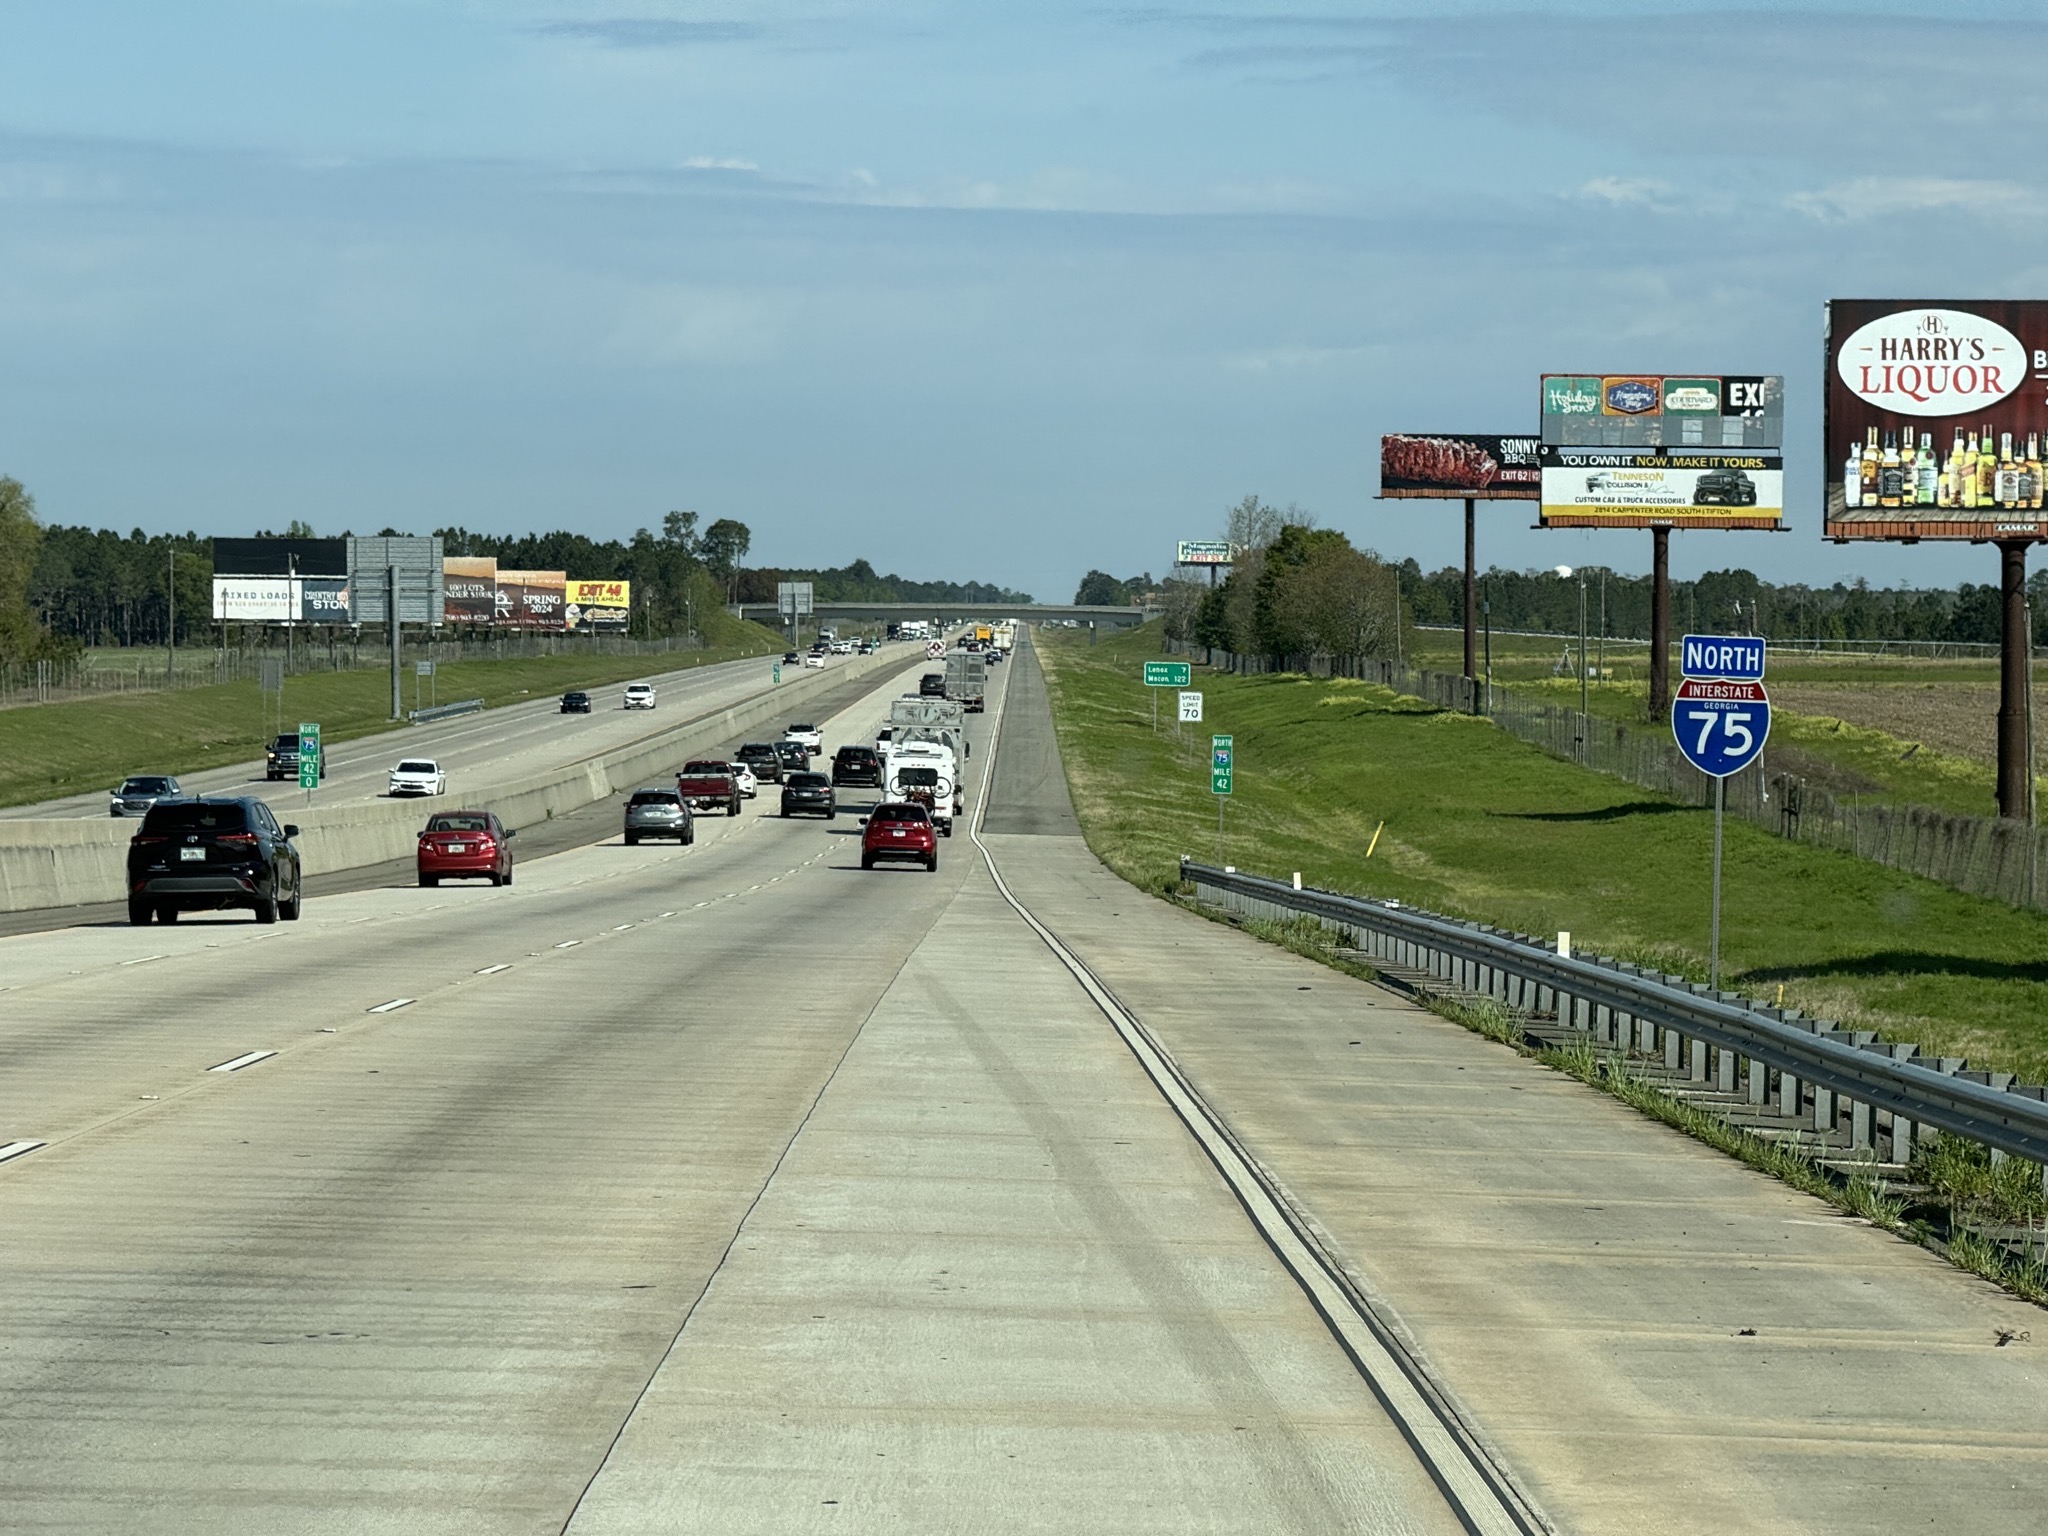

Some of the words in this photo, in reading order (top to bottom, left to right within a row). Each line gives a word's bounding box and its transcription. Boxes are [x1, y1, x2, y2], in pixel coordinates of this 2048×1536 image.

[1880, 337, 1985, 361] HARRY'S
[1859, 365, 2006, 402] LIQUOR
[1549, 390, 1597, 411] Holiday
[1563, 401, 1590, 413] Inn
[1504, 454, 1526, 465] BBQ
[1561, 455, 1586, 466] YOU
[1589, 456, 1620, 466] OWN
[1621, 456, 1634, 466] IT.
[1636, 456, 1670, 467] NOW,
[1673, 457, 1707, 467] MAKE
[1710, 457, 1720, 467] IT
[1722, 458, 1766, 468] YOURS.
[1501, 471, 1517, 480] EXIT
[1518, 471, 1528, 480] 62
[1997, 524, 2036, 532] LAMAR
[579, 584, 605, 596] EXIT
[305, 591, 336, 600] COUNTRY
[523, 595, 560, 604] SPRING
[530, 605, 553, 613] 2024
[1687, 642, 1760, 671] NORTH
[1689, 684, 1754, 698] INTERSTATE
[1704, 702, 1739, 710] GEORGIA
[1183, 709, 1198, 718] 70
[300, 725, 319, 734] NORTH
[1688, 711, 1753, 757] 75
[304, 740, 315, 750] 75
[1213, 738, 1232, 747] NORTH
[301, 755, 318, 763] MILE
[1218, 754, 1228, 762] 75
[304, 763, 315, 774] 42
[1214, 768, 1230, 776] MILE
[1216, 779, 1227, 788] 42
